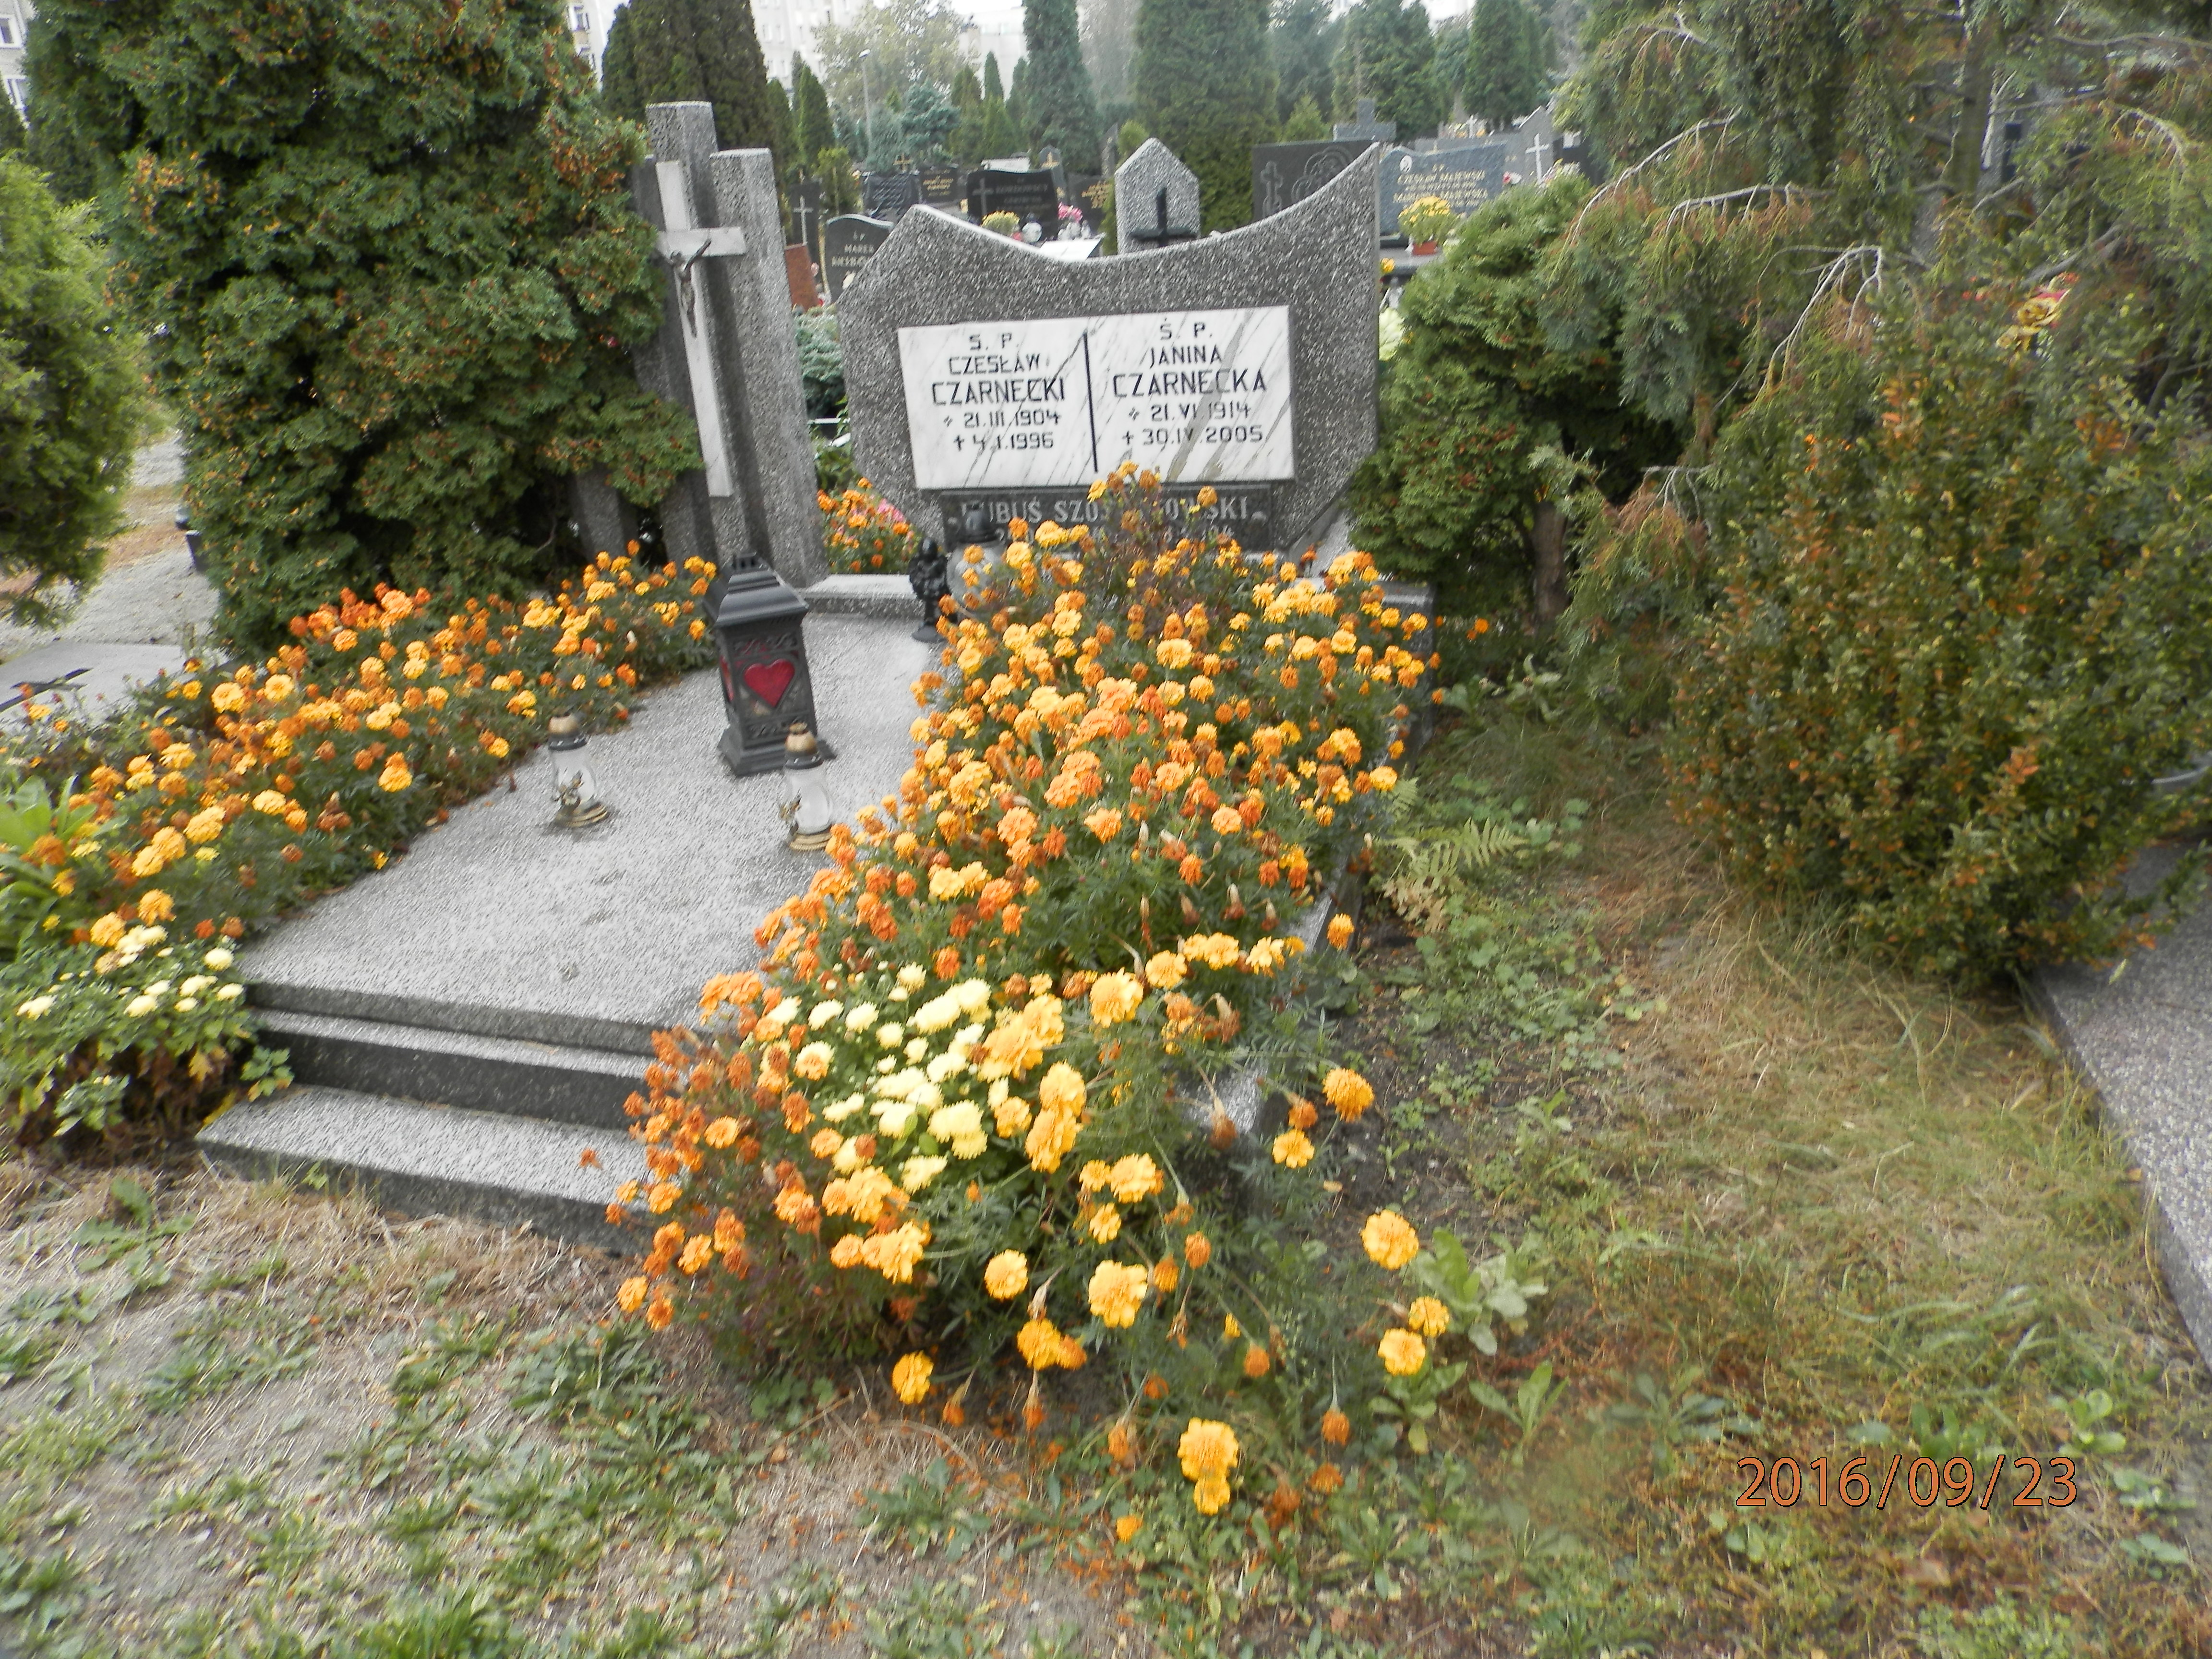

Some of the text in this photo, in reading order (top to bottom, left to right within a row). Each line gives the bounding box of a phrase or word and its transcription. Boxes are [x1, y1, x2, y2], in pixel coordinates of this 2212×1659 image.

[949, 353, 1040, 375] CZESŁAW
[1149, 343, 1222, 369] JANINA
[932, 377, 1065, 406] CZARNECKI
[1113, 368, 1266, 398] CZARNECKA
